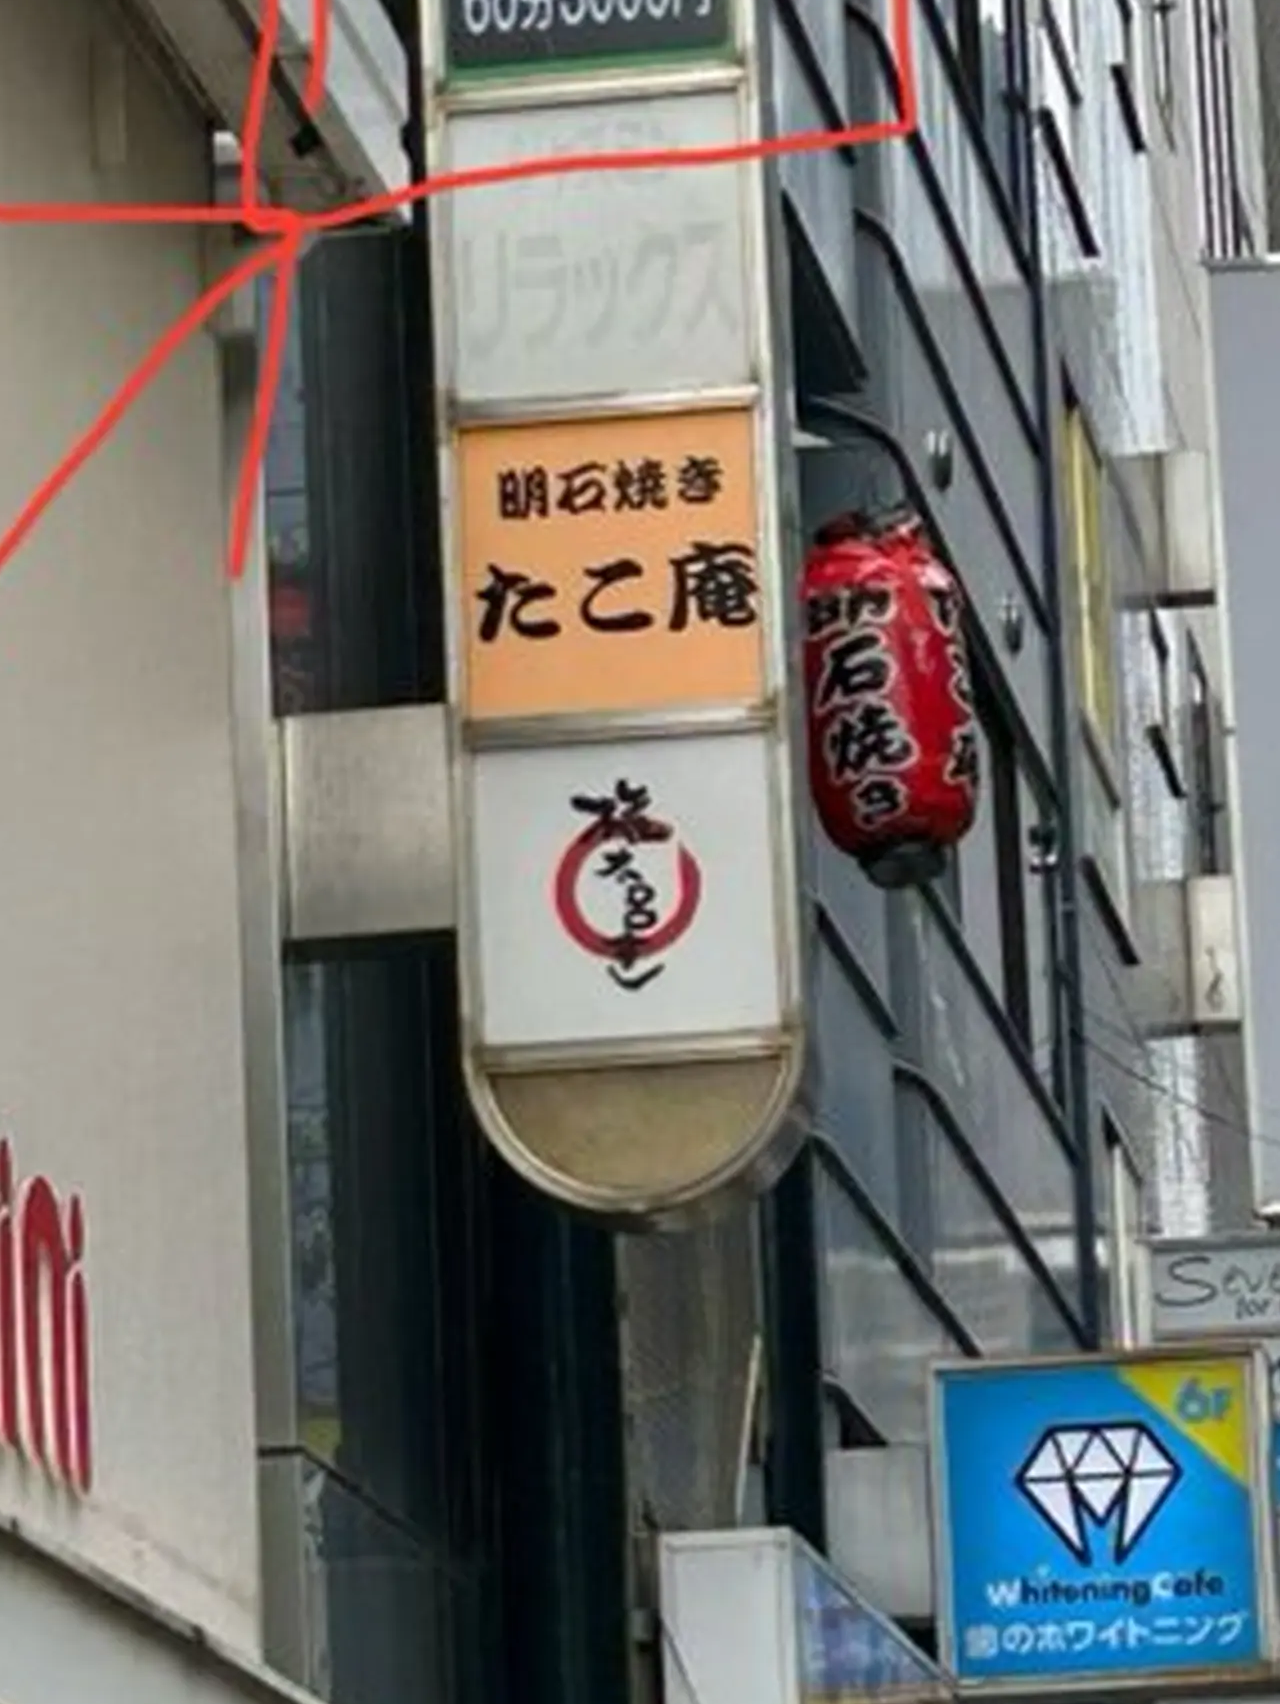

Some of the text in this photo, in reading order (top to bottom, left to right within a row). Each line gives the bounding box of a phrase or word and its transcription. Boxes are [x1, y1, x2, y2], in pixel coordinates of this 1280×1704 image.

[498, 454, 723, 520] 明石焼き
[477, 541, 758, 643] たこ庵
